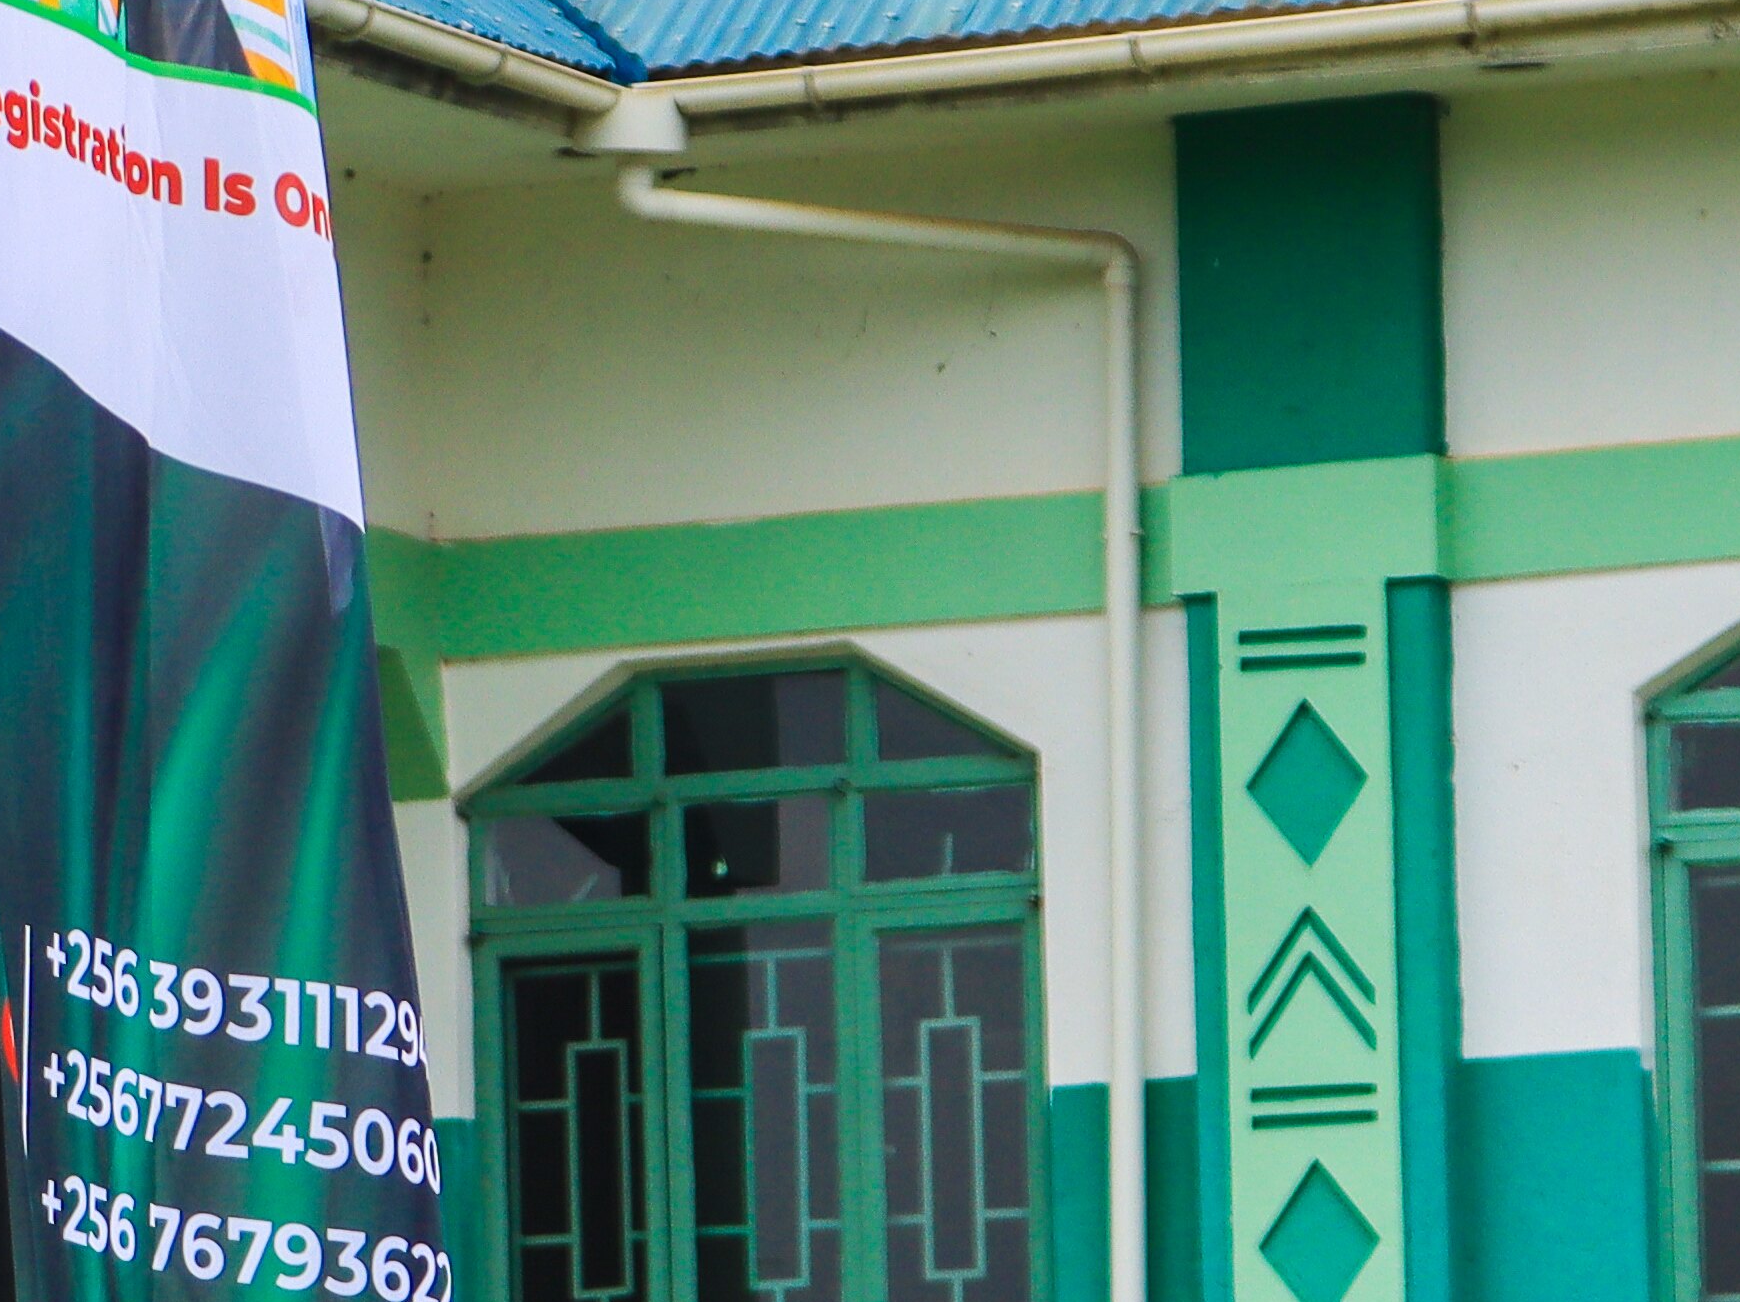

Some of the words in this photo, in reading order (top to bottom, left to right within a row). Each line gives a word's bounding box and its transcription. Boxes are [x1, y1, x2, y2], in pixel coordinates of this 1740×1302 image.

[204, 157, 257, 217] Is
[274, 171, 331, 242] On
[46, 928, 140, 1019] +256
[41, 1174, 137, 1263] +256
